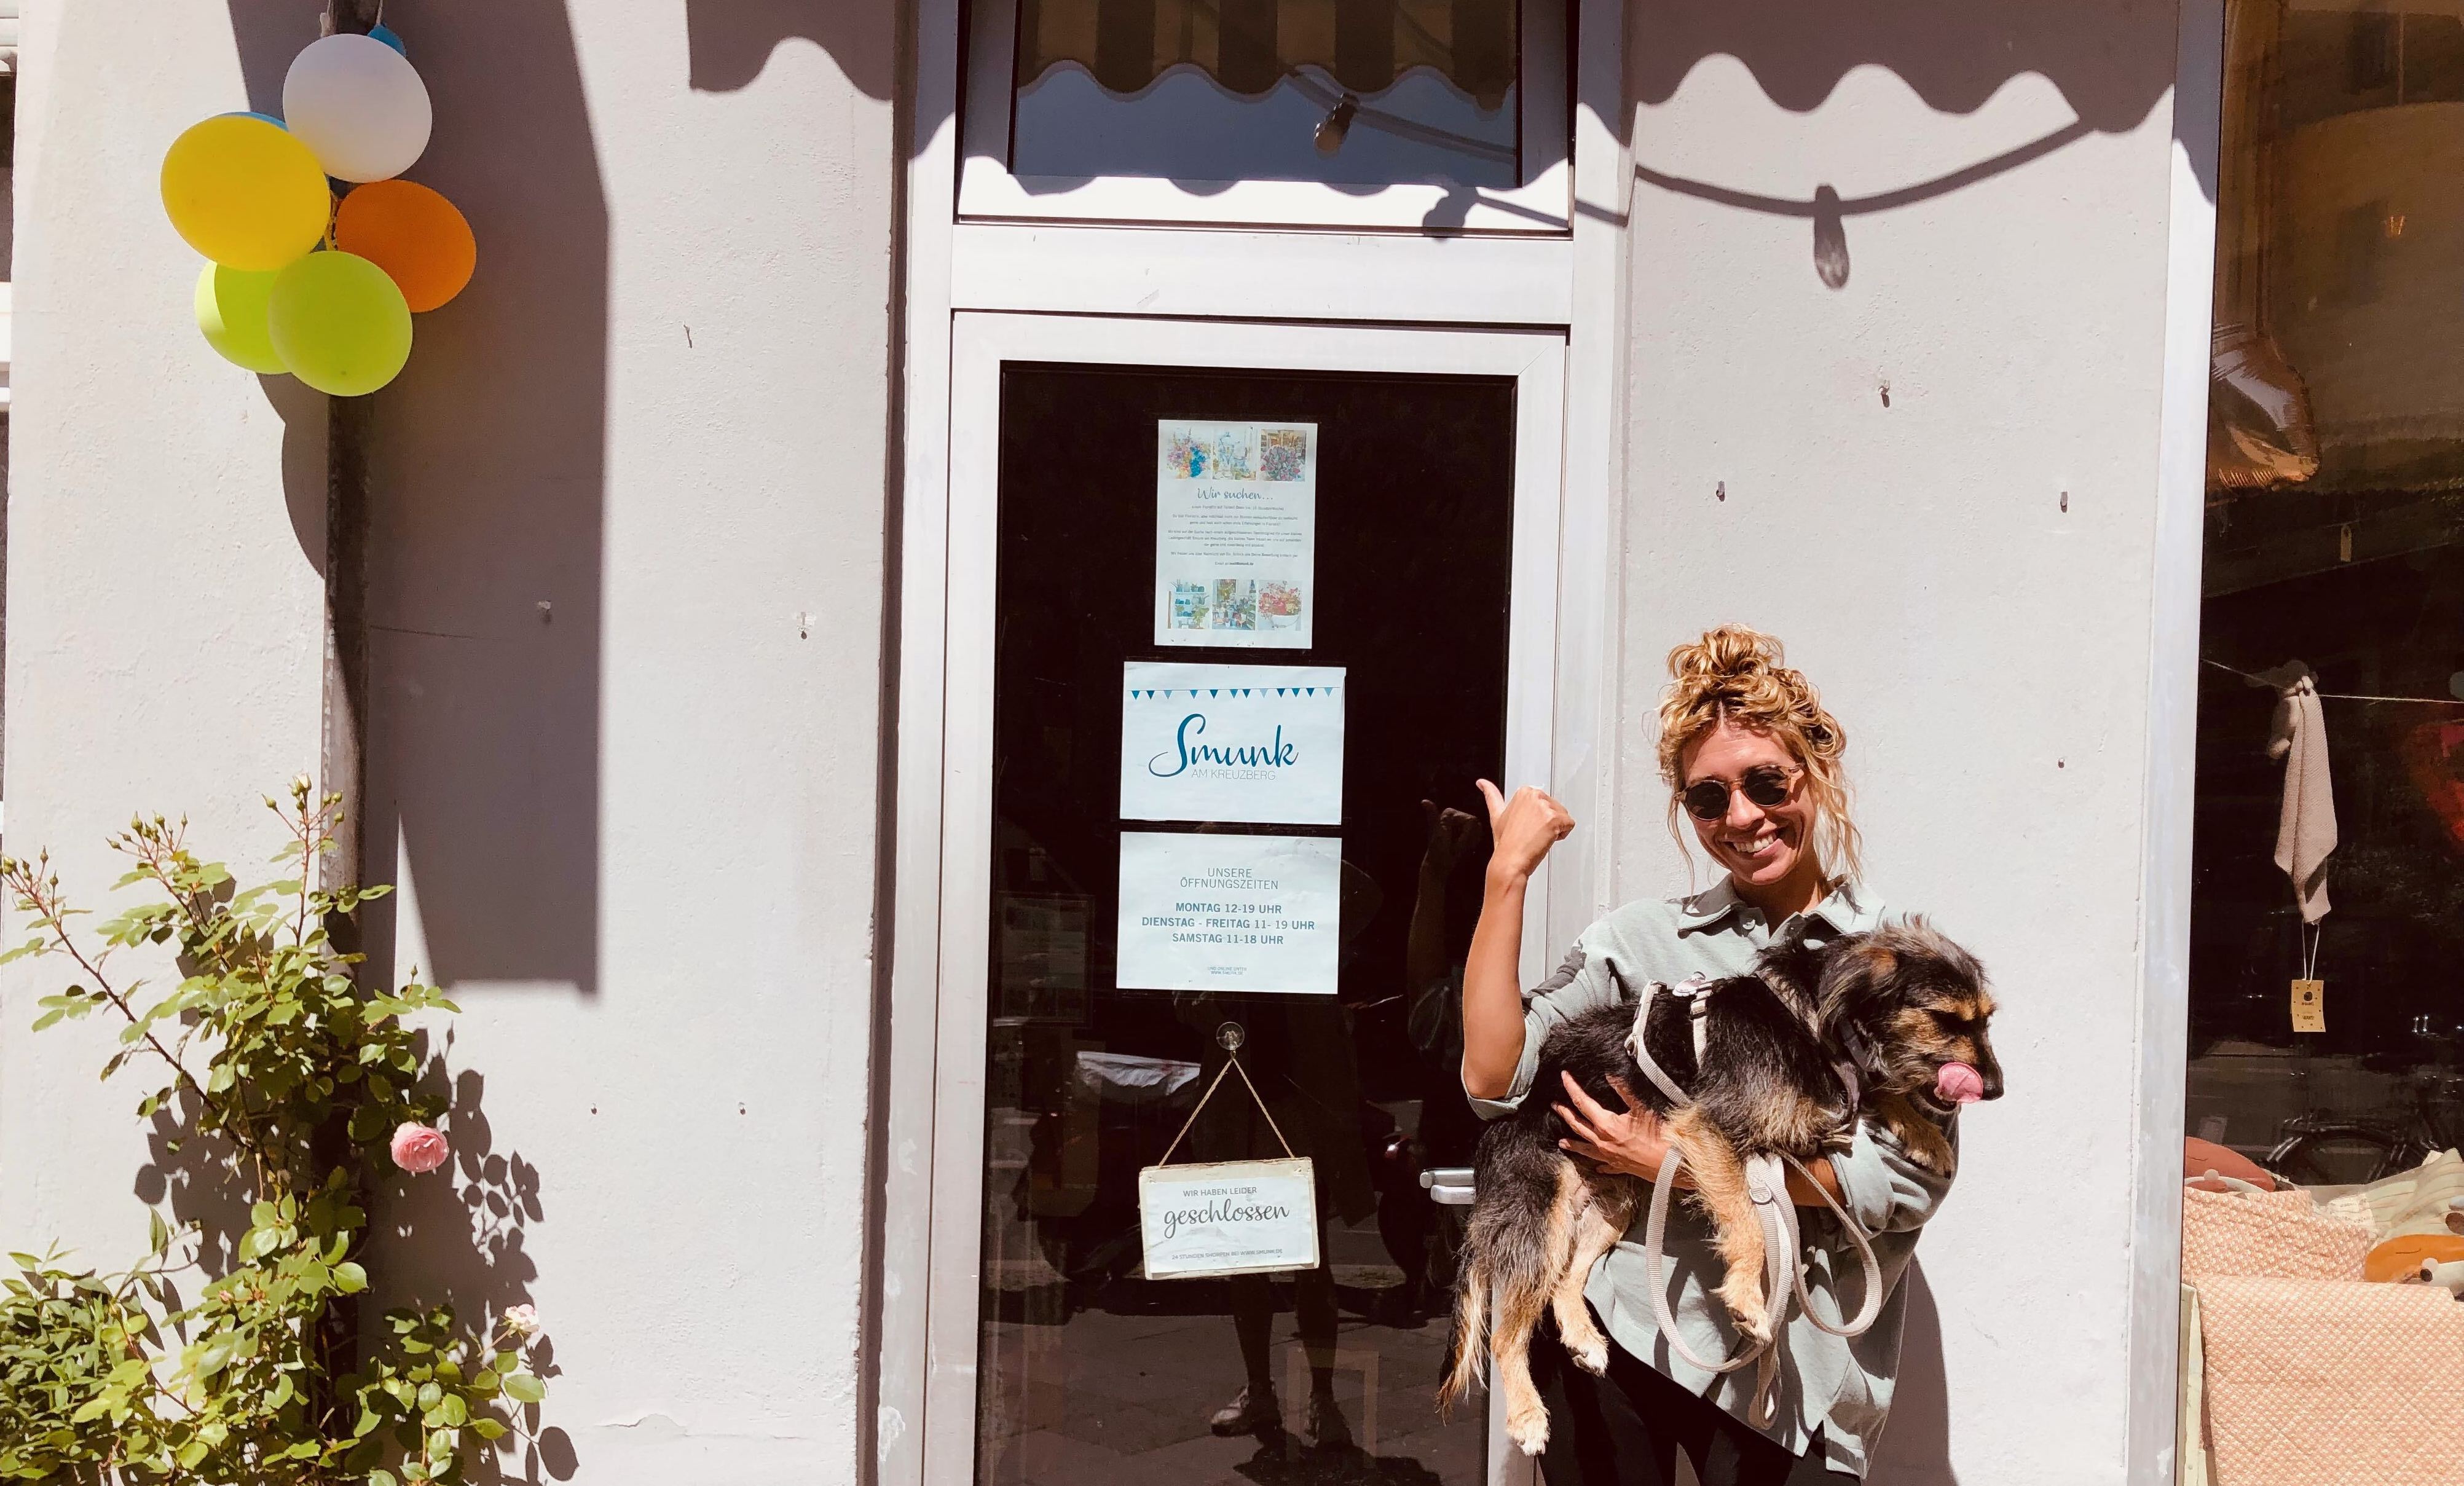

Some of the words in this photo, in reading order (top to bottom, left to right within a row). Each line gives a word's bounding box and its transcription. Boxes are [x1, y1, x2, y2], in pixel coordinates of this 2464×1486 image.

[1197, 486, 1221, 500] Wir
[1148, 713, 1299, 777] Smunk
[1191, 769, 1208, 778] AM
[1211, 769, 1276, 780] KREUZBERG
[1207, 867, 1253, 878] UNSERE
[1179, 876, 1278, 890] ÖFFNUNGSZEITEN
[1175, 902, 1221, 913] MONTAG
[1224, 903, 1255, 913] 12-19
[1259, 905, 1282, 914] UHR
[1141, 917, 1195, 927] DIENSTAG
[1205, 918, 1250, 929] FREITAG
[1275, 920, 1288, 930] 19
[1291, 921, 1315, 930] UHR
[1171, 933, 1222, 943] SAMSTAG
[1226, 934, 1257, 944] 11-18
[1260, 935, 1284, 945] UHR
[1163, 1198, 1290, 1239] geschlossen
